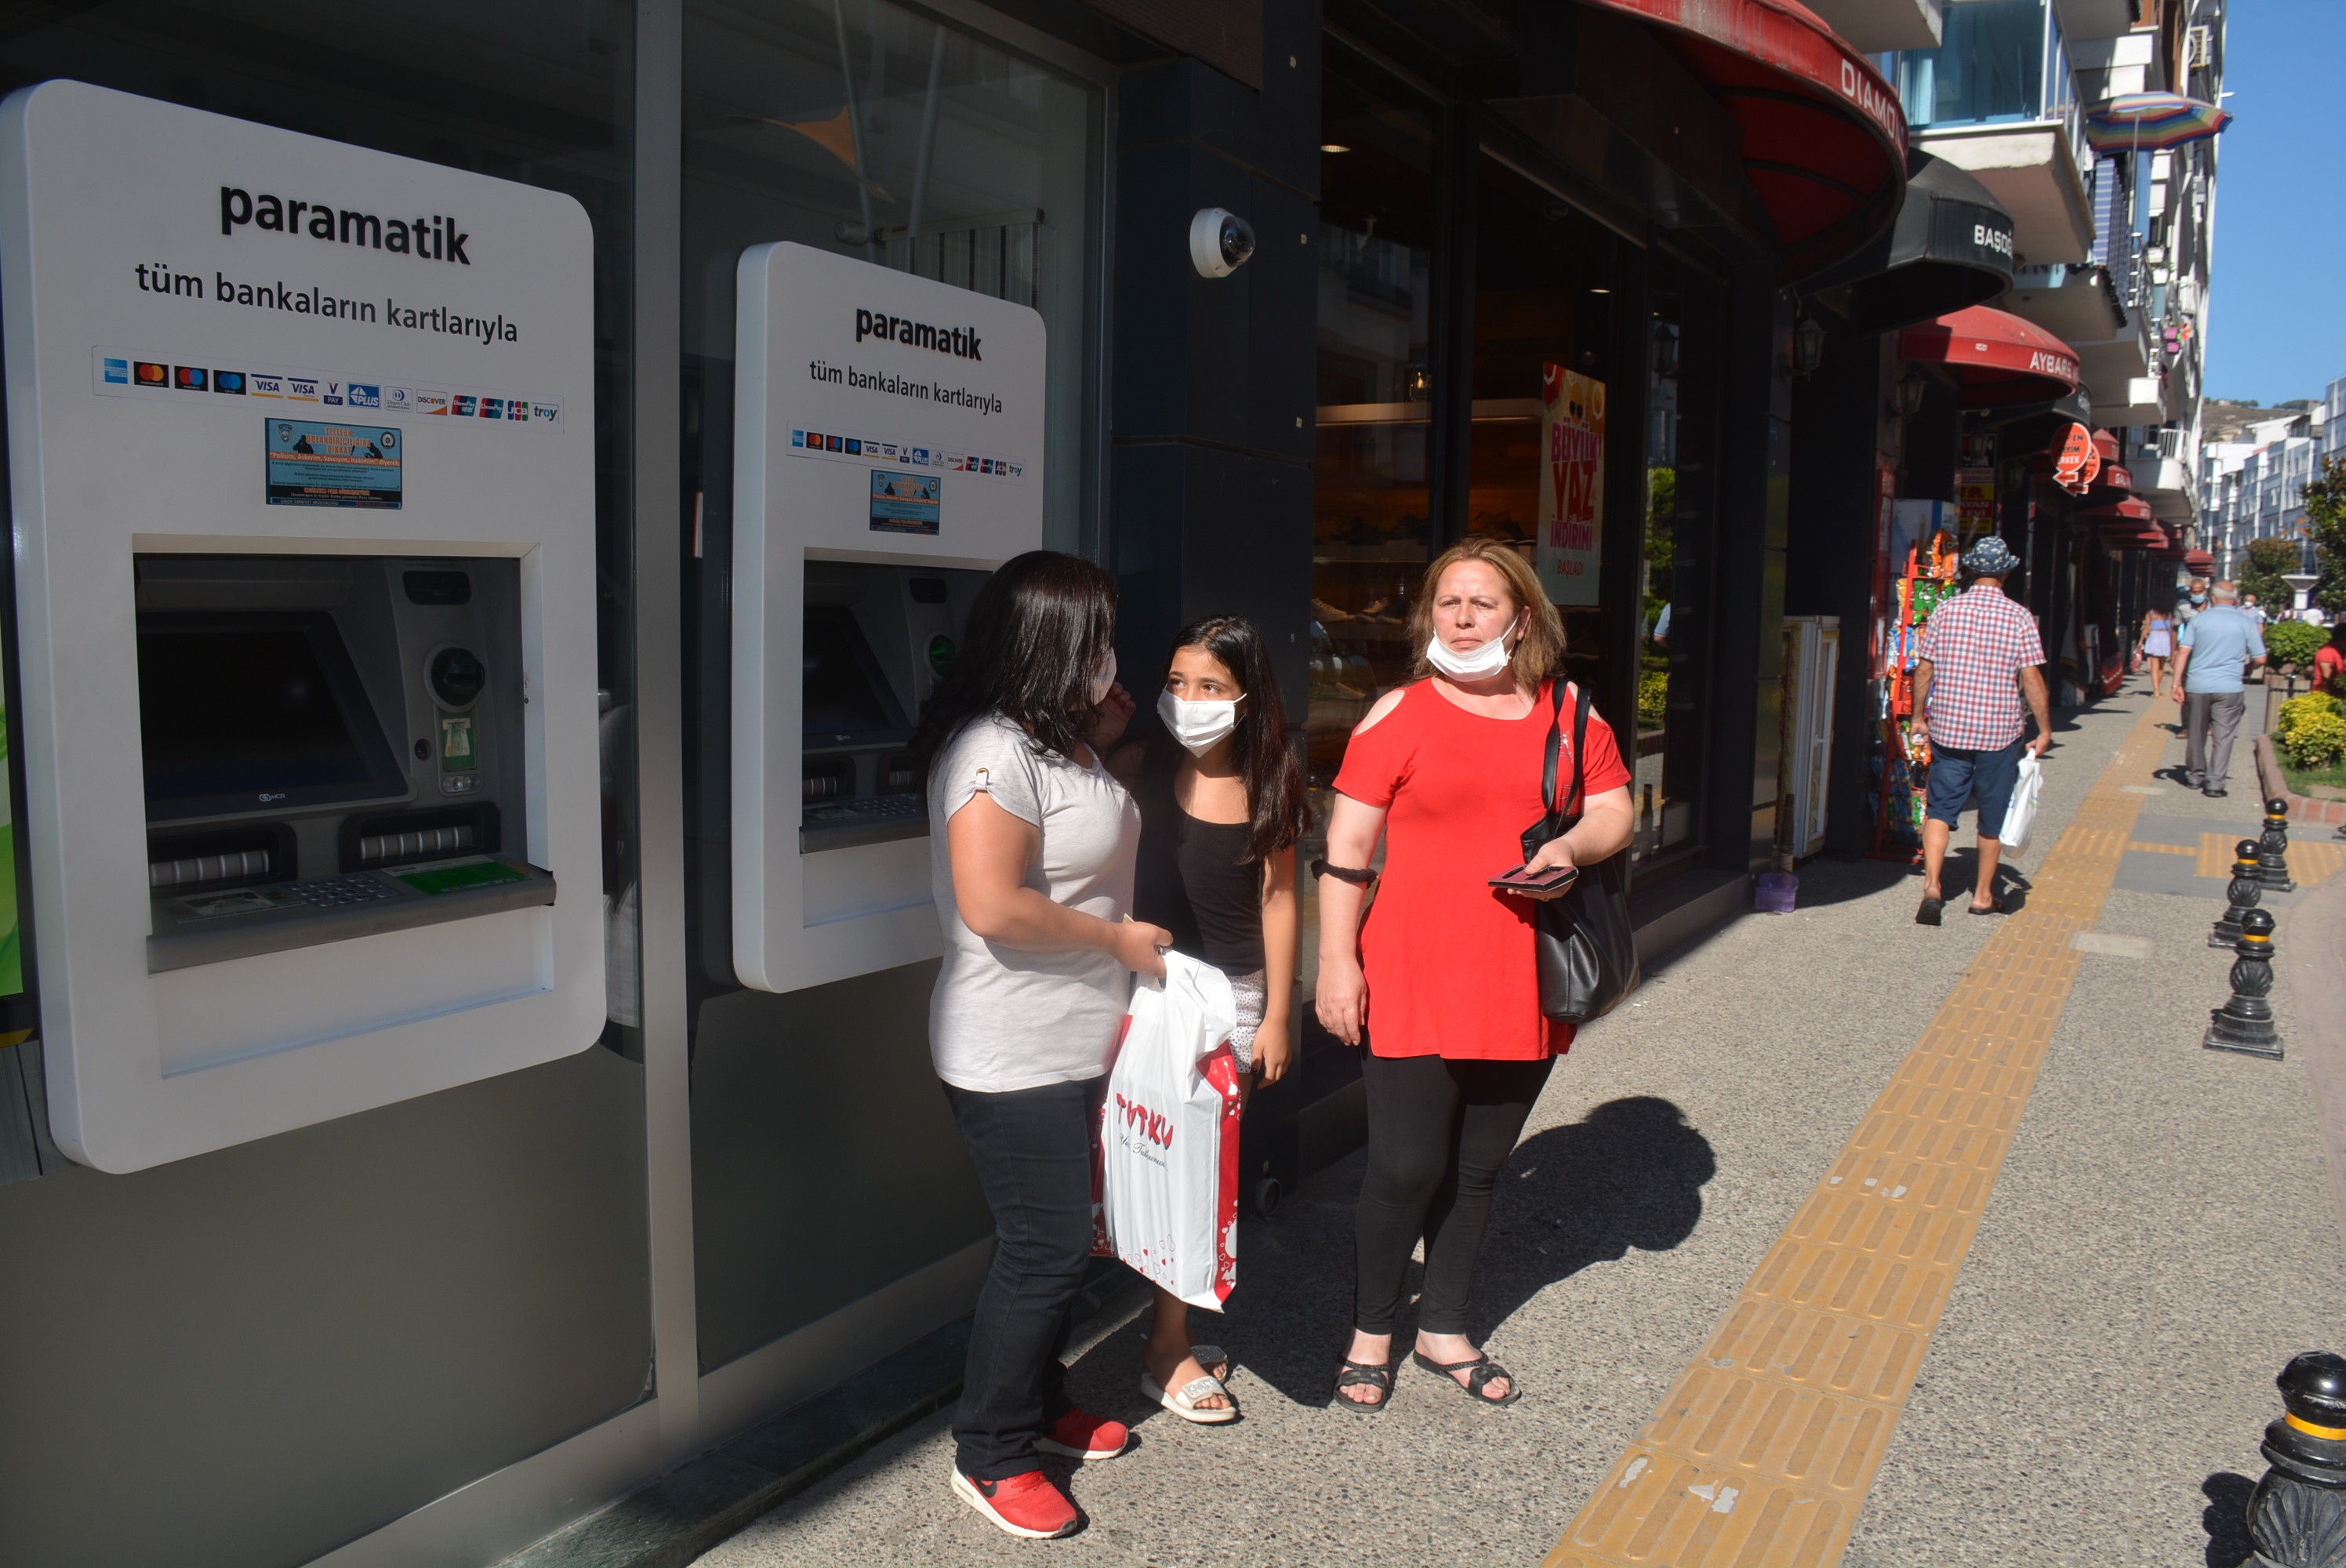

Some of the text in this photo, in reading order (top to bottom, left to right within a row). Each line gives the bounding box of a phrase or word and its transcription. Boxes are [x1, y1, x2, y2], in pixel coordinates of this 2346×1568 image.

[220, 184, 471, 266] paramatik
[135, 262, 518, 346] tüm bankaların kartlarıyla
[855, 307, 982, 361] paramatik
[255, 380, 280, 392] VISA
[291, 383, 315, 394] VISA
[328, 382, 339, 394] V
[809, 360, 1004, 416] tüm bankaların kartlarıyla
[358, 395, 379, 407] PLUS
[418, 396, 445, 405] DISCOVER
[481, 403, 503, 413] UnionPay
[507, 406, 528, 416] JCB
[534, 405, 557, 422] troy
[326, 427, 352, 437] TELEFON
[866, 445, 878, 454] VISA
[1551, 416, 1598, 473] BÜYÜK
[883, 447, 895, 456] VISA
[917, 456, 928, 464] PLUS
[1009, 464, 1022, 477] troy
[1553, 459, 1594, 522] YAZ
[1550, 514, 1593, 552] İNDİRİMİ
[1117, 1093, 1174, 1150] TUTKU
